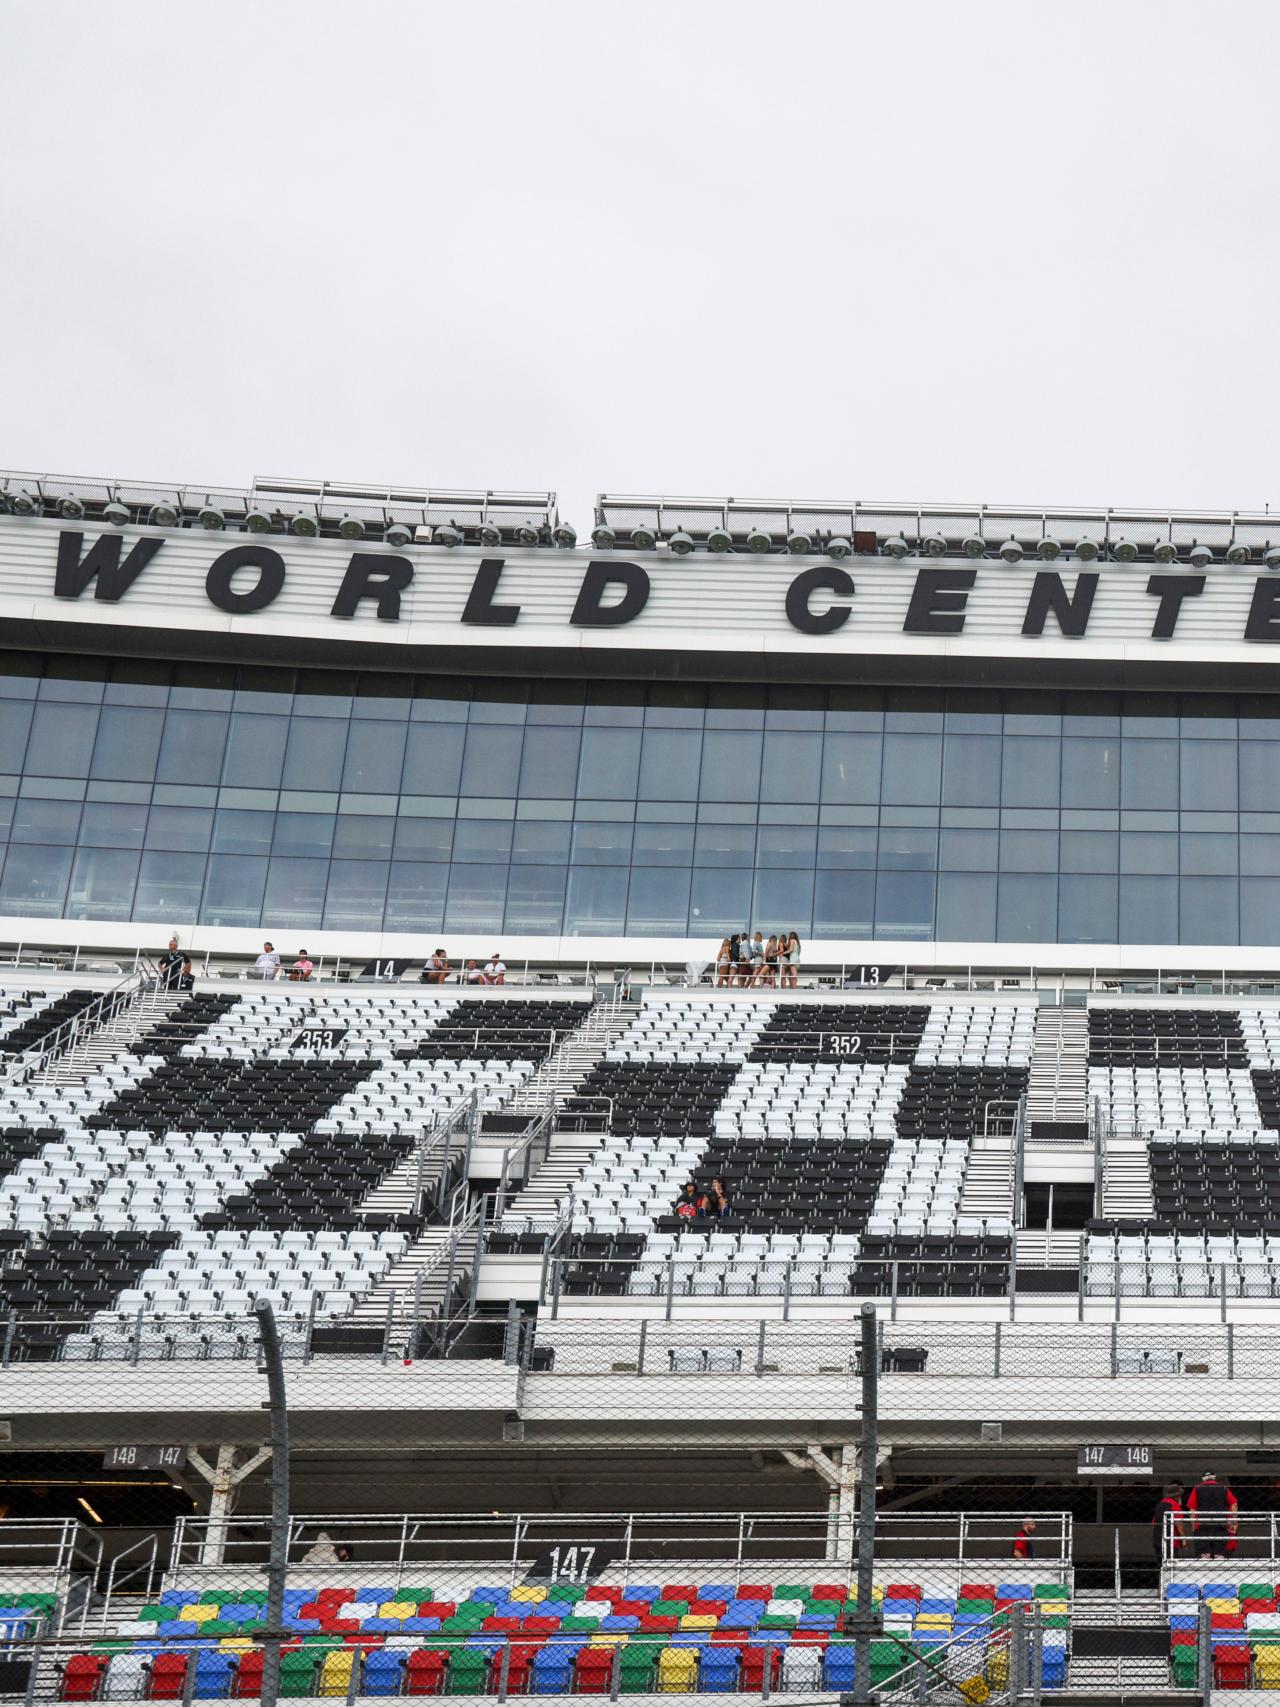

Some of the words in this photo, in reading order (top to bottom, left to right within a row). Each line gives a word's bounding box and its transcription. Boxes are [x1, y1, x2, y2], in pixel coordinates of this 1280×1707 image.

[54, 531, 652, 626] WORLD
[375, 960, 395, 980] L4
[861, 966, 879, 986] L3
[302, 1030, 333, 1050] 353
[830, 1035, 861, 1055] 352
[112, 1446, 137, 1464] 148
[158, 1447, 181, 1465] 147
[1084, 1446, 1105, 1463] 147
[1126, 1447, 1149, 1463] 146
[549, 1546, 596, 1584] 147
